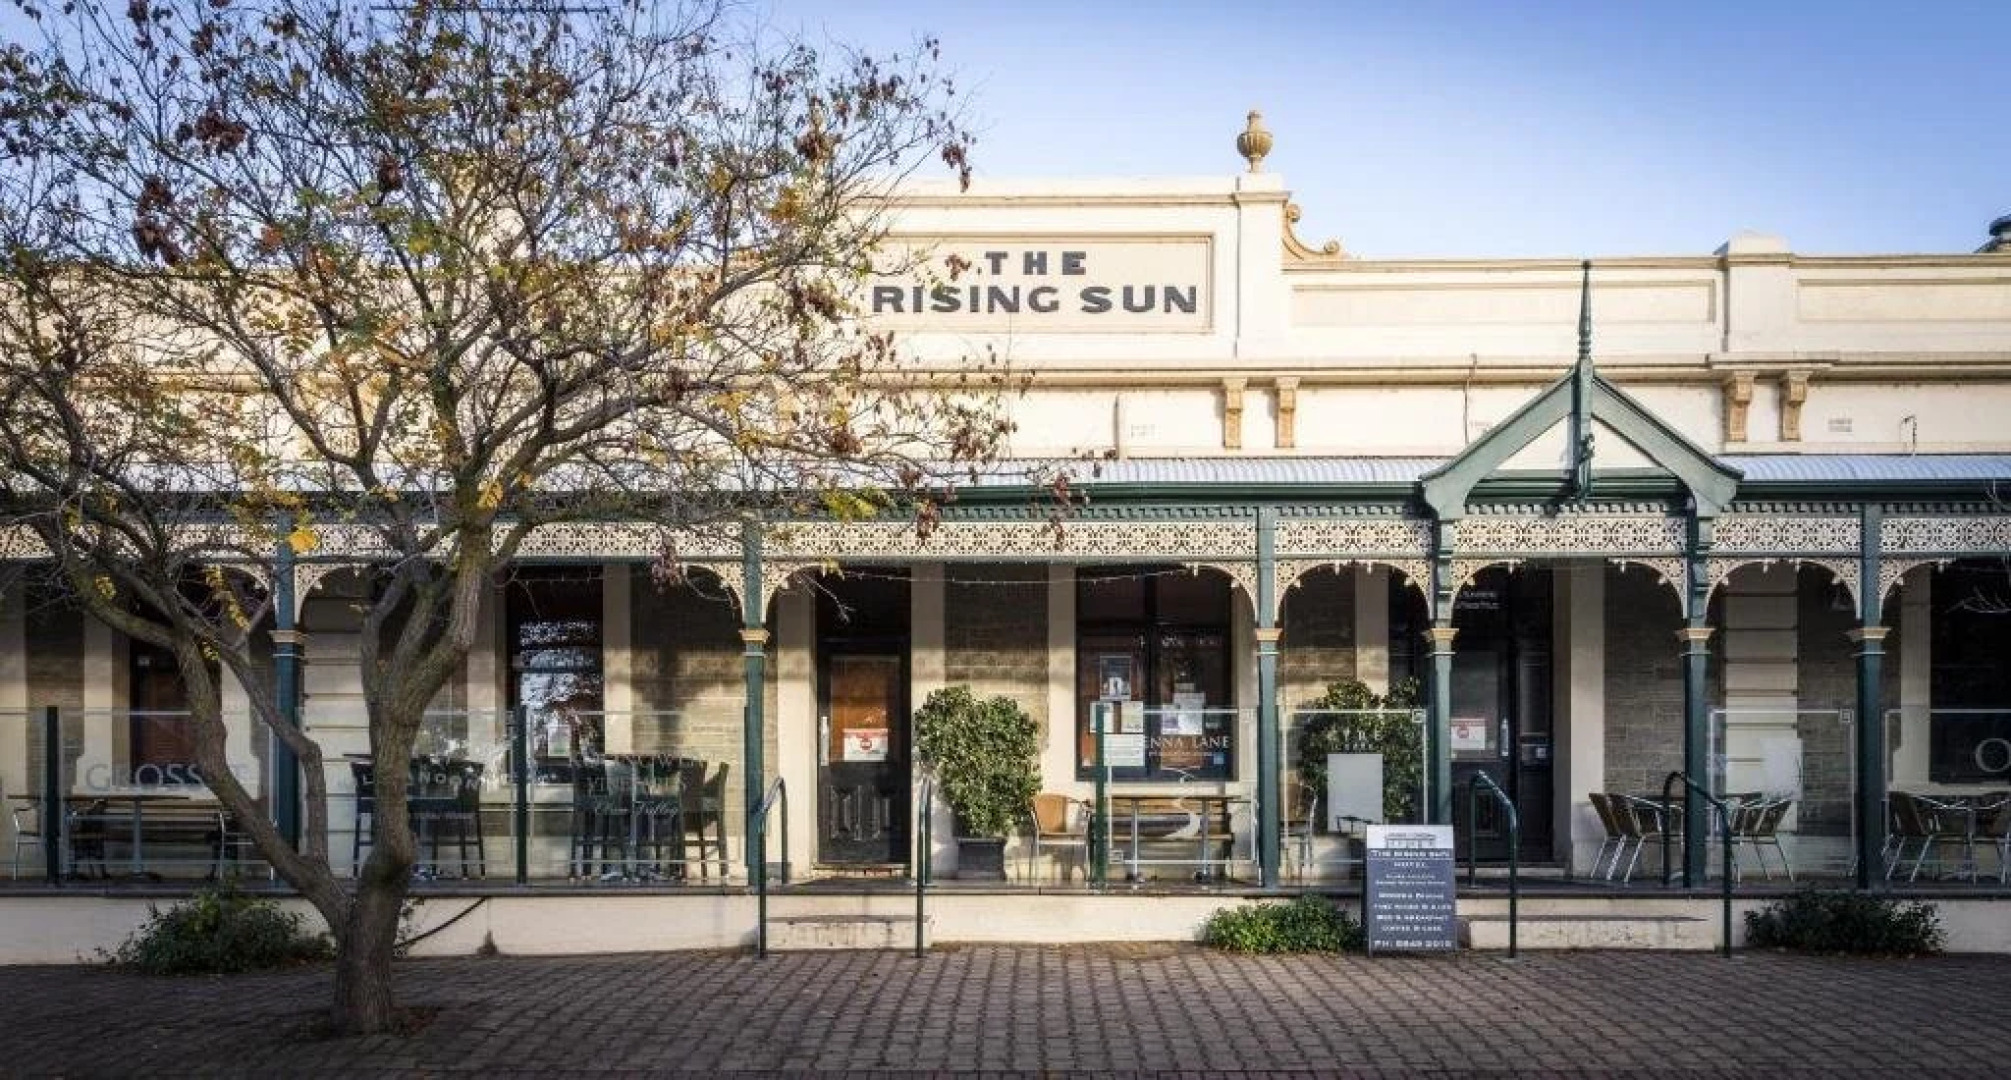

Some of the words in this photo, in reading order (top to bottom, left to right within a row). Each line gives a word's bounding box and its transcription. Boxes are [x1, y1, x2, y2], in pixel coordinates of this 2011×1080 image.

[985, 251, 1087, 275] THE
[872, 285, 1060, 314] RISING
[1080, 285, 1197, 314] SUN
